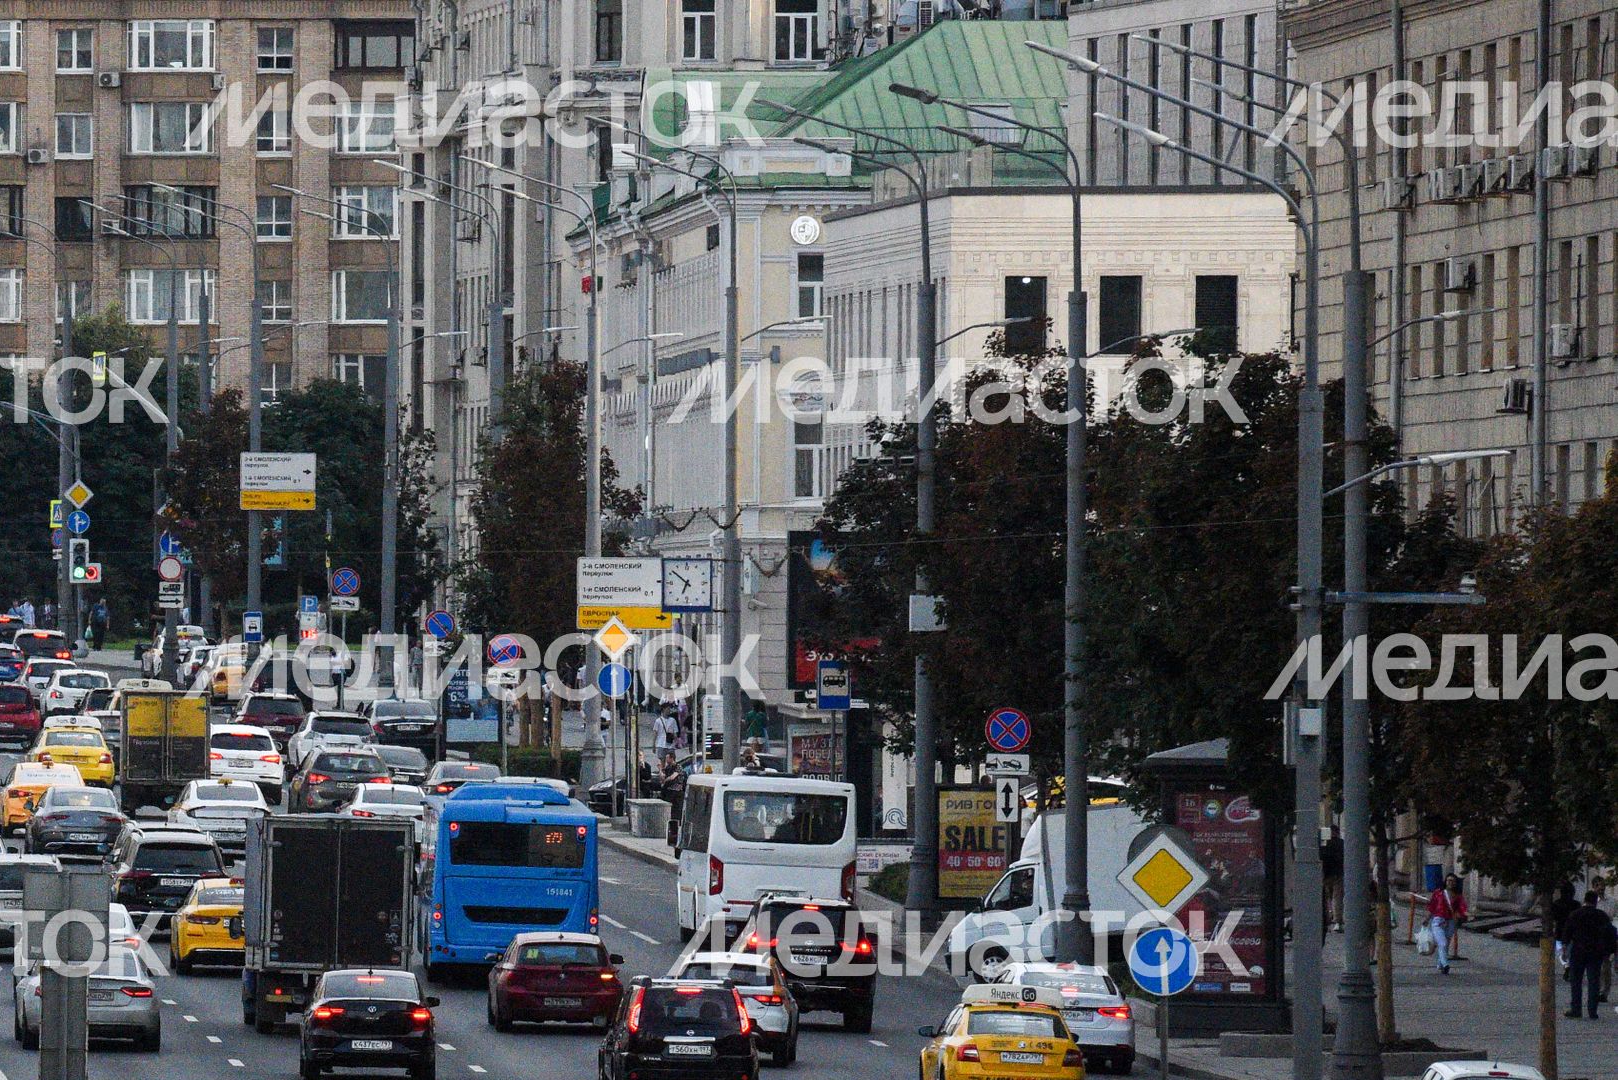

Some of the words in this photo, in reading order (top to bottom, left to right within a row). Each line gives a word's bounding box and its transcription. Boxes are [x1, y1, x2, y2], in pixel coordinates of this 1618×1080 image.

[946, 800, 973, 810] РИВ
[945, 825, 1006, 852] SALE
[991, 988, 1020, 1000] Яндекс
[1023, 989, 1035, 1000] Go
